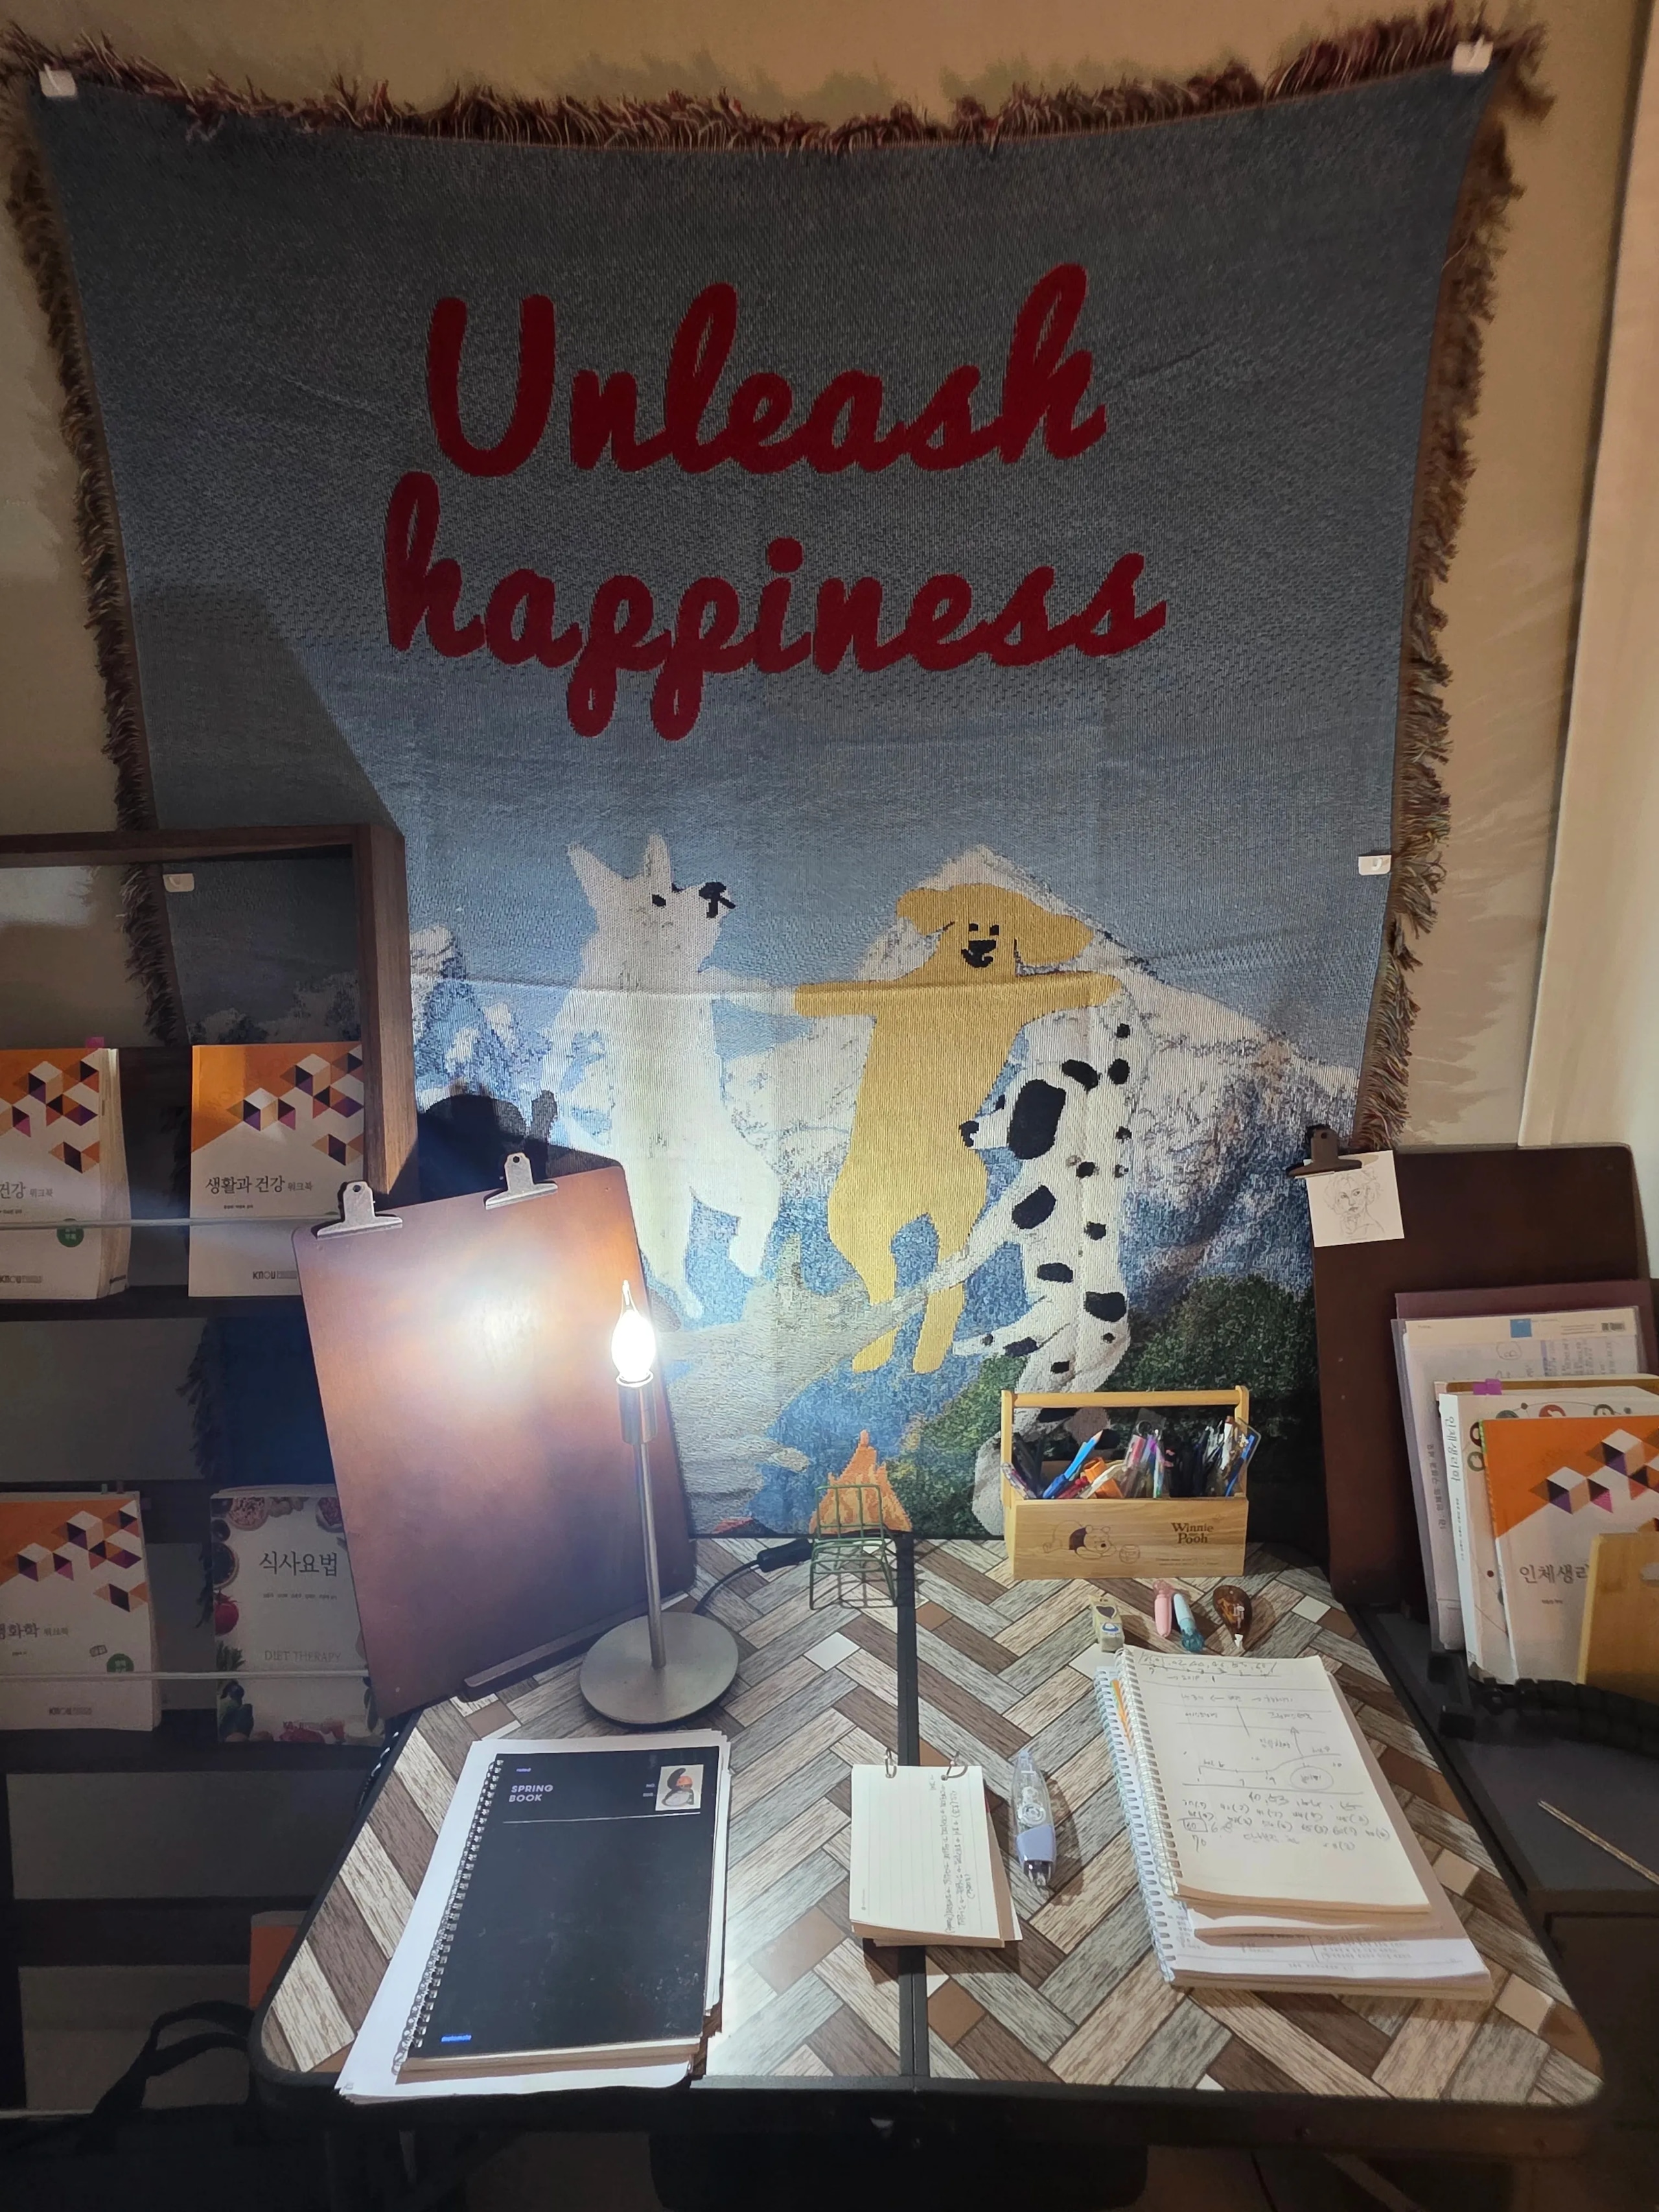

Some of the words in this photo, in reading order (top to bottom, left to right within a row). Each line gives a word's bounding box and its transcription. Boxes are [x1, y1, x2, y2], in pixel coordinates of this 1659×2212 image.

[425, 261, 1108, 476] Unleash
[385, 471, 1167, 740] happiness
[0, 1182, 26, 1199] 건강
[205, 1176, 252, 1194] 생활과
[255, 1175, 285, 1193] 건강
[287, 1181, 314, 1192] 워크북
[1170, 1522, 1214, 1533] Winnie
[1178, 1532, 1208, 1544] Pooh
[259, 1550, 338, 1577] 식사요법
[264, 1650, 290, 1661] DIET
[293, 1651, 342, 1662] THERAPY
[511, 1784, 553, 1793] SPRING
[508, 1794, 542, 1802] BOOK
